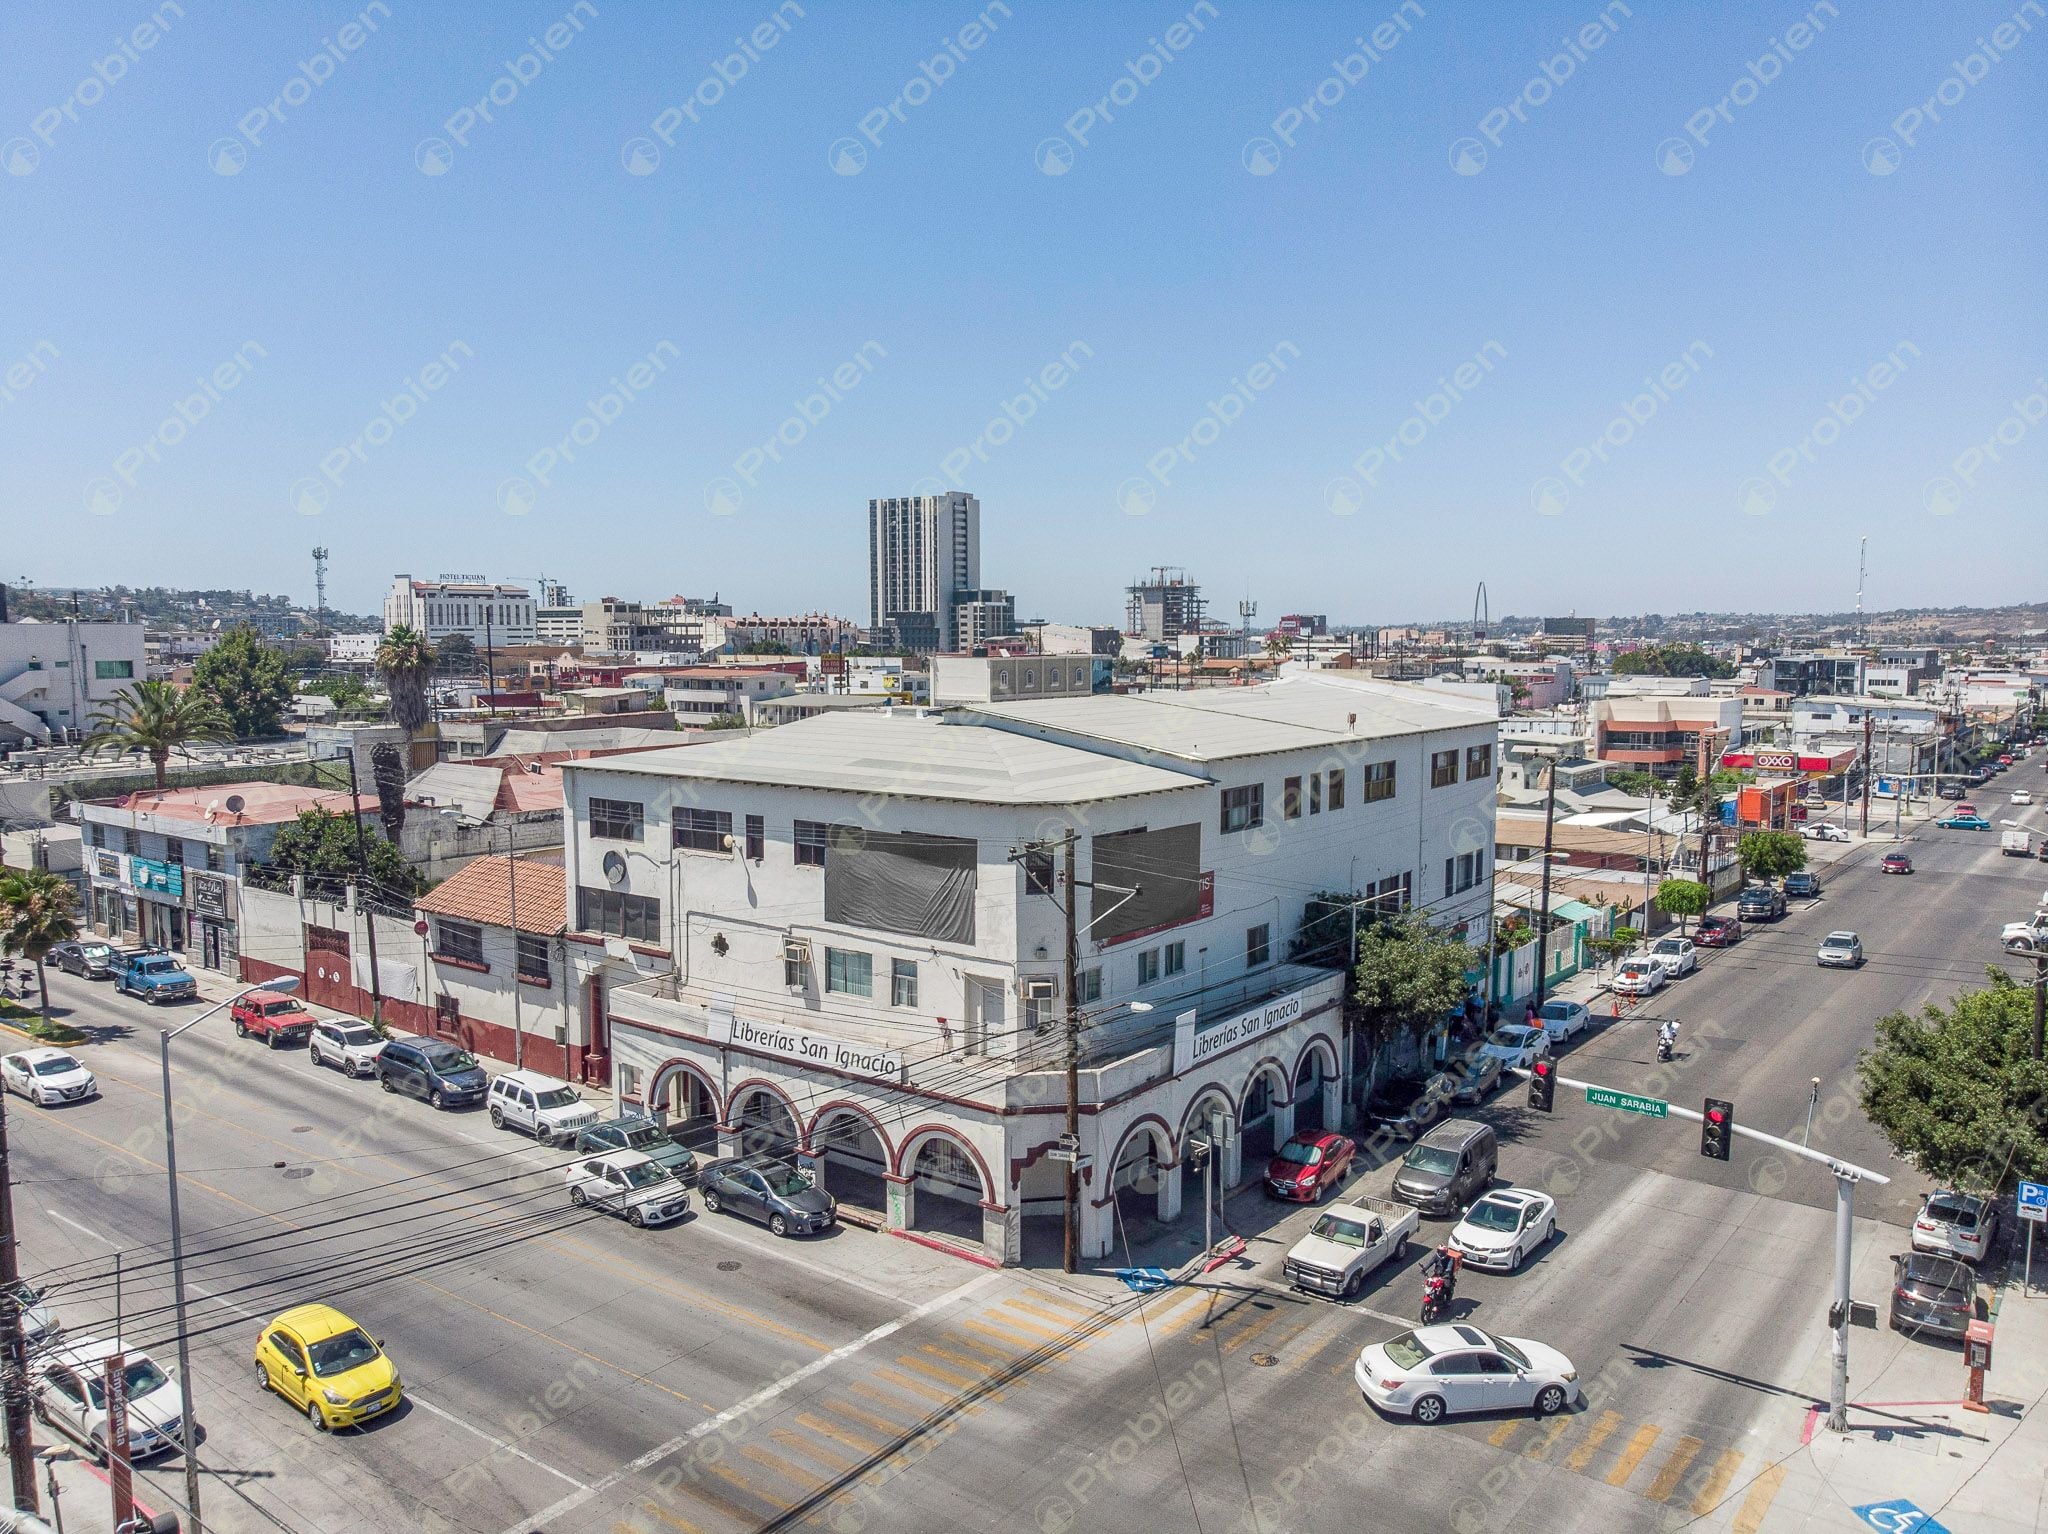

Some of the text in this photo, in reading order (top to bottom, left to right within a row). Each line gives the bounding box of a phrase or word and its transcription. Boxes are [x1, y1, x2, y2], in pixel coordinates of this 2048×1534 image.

[1758, 755, 1792, 767] OXXO
[1193, 998, 1299, 1059] Librerías San Ignacio
[733, 1020, 895, 1075] Librerías San Ignacio
[1592, 1093, 1617, 1104] JUAN
[1620, 1097, 1662, 1113] SARABIA
[2022, 1184, 2039, 1202] P
